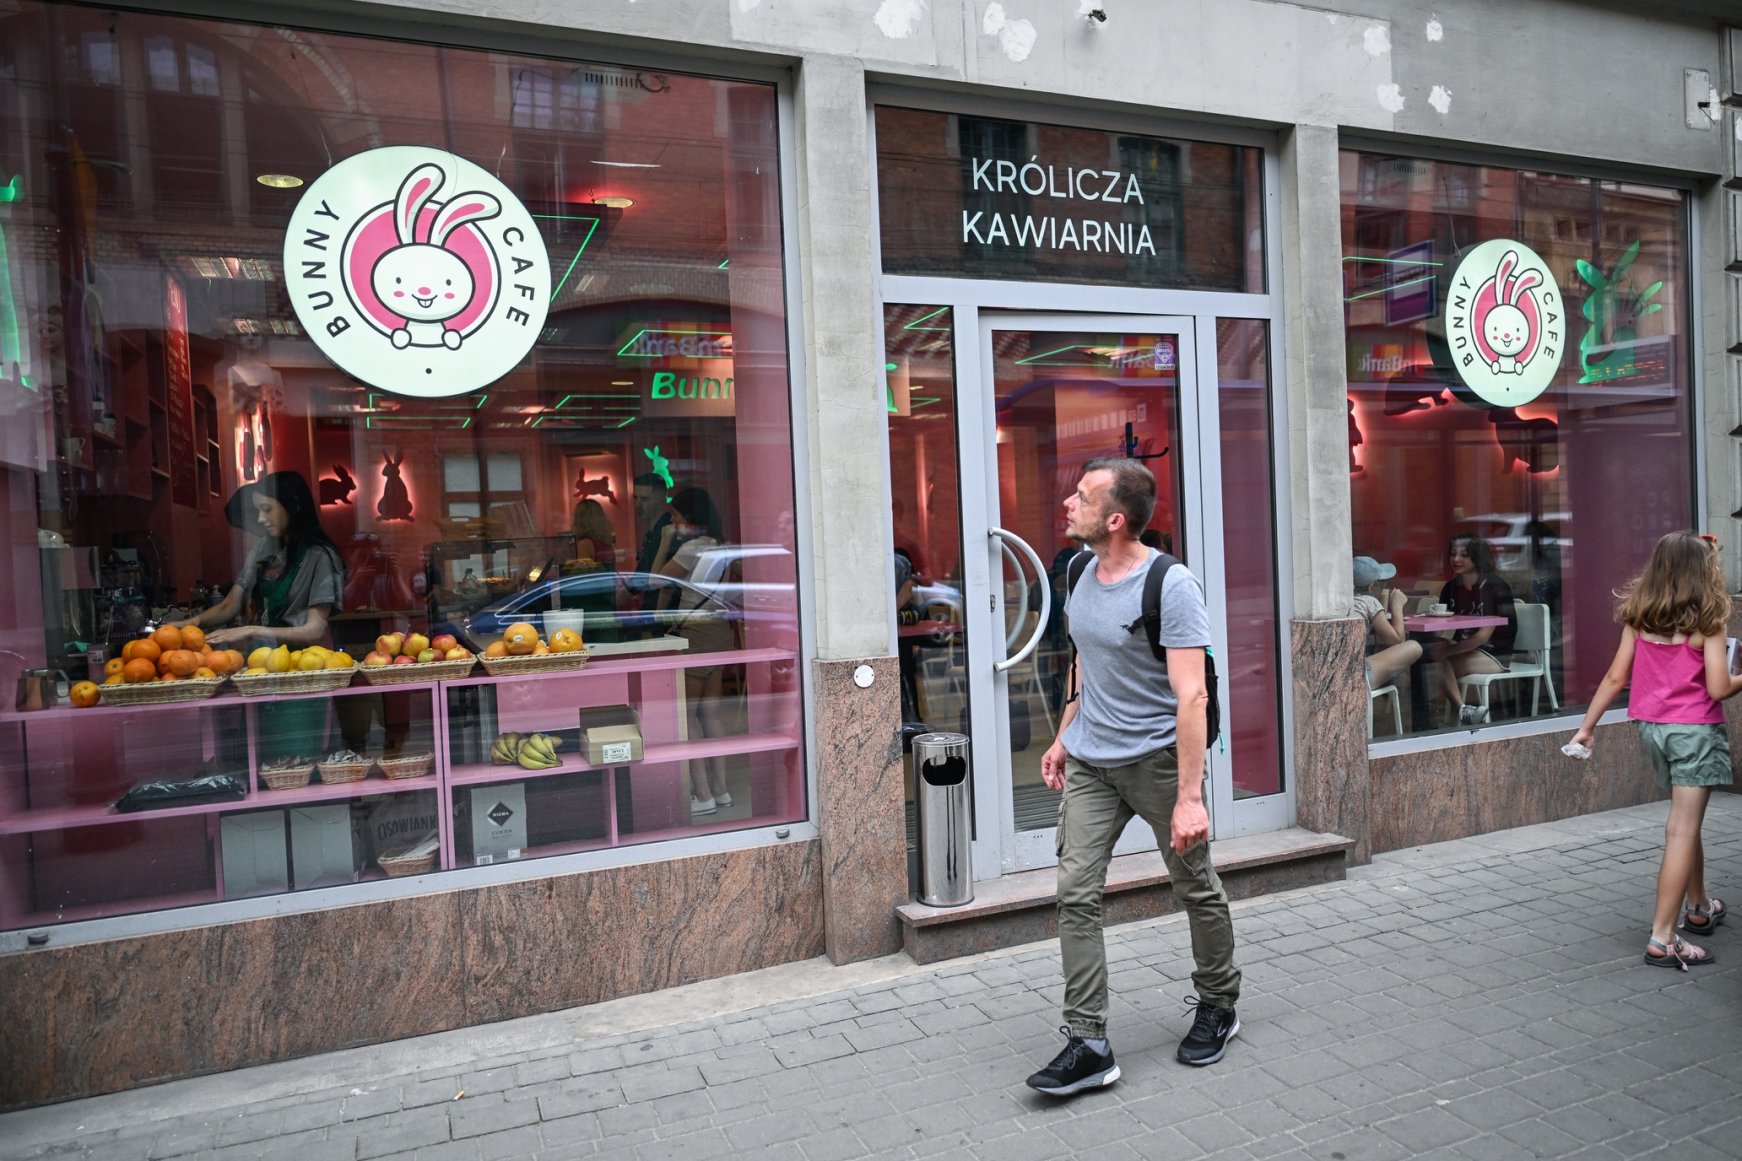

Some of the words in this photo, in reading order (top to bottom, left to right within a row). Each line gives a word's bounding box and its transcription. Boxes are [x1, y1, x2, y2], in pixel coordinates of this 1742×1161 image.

[972, 155, 1144, 204] KRÓLICZA
[962, 210, 1156, 256] KAWIARNIA
[301, 199, 351, 338] BUNNY
[502, 226, 535, 327] CAFE
[1453, 276, 1474, 368] BUNNY
[1543, 291, 1558, 359] CAFE
